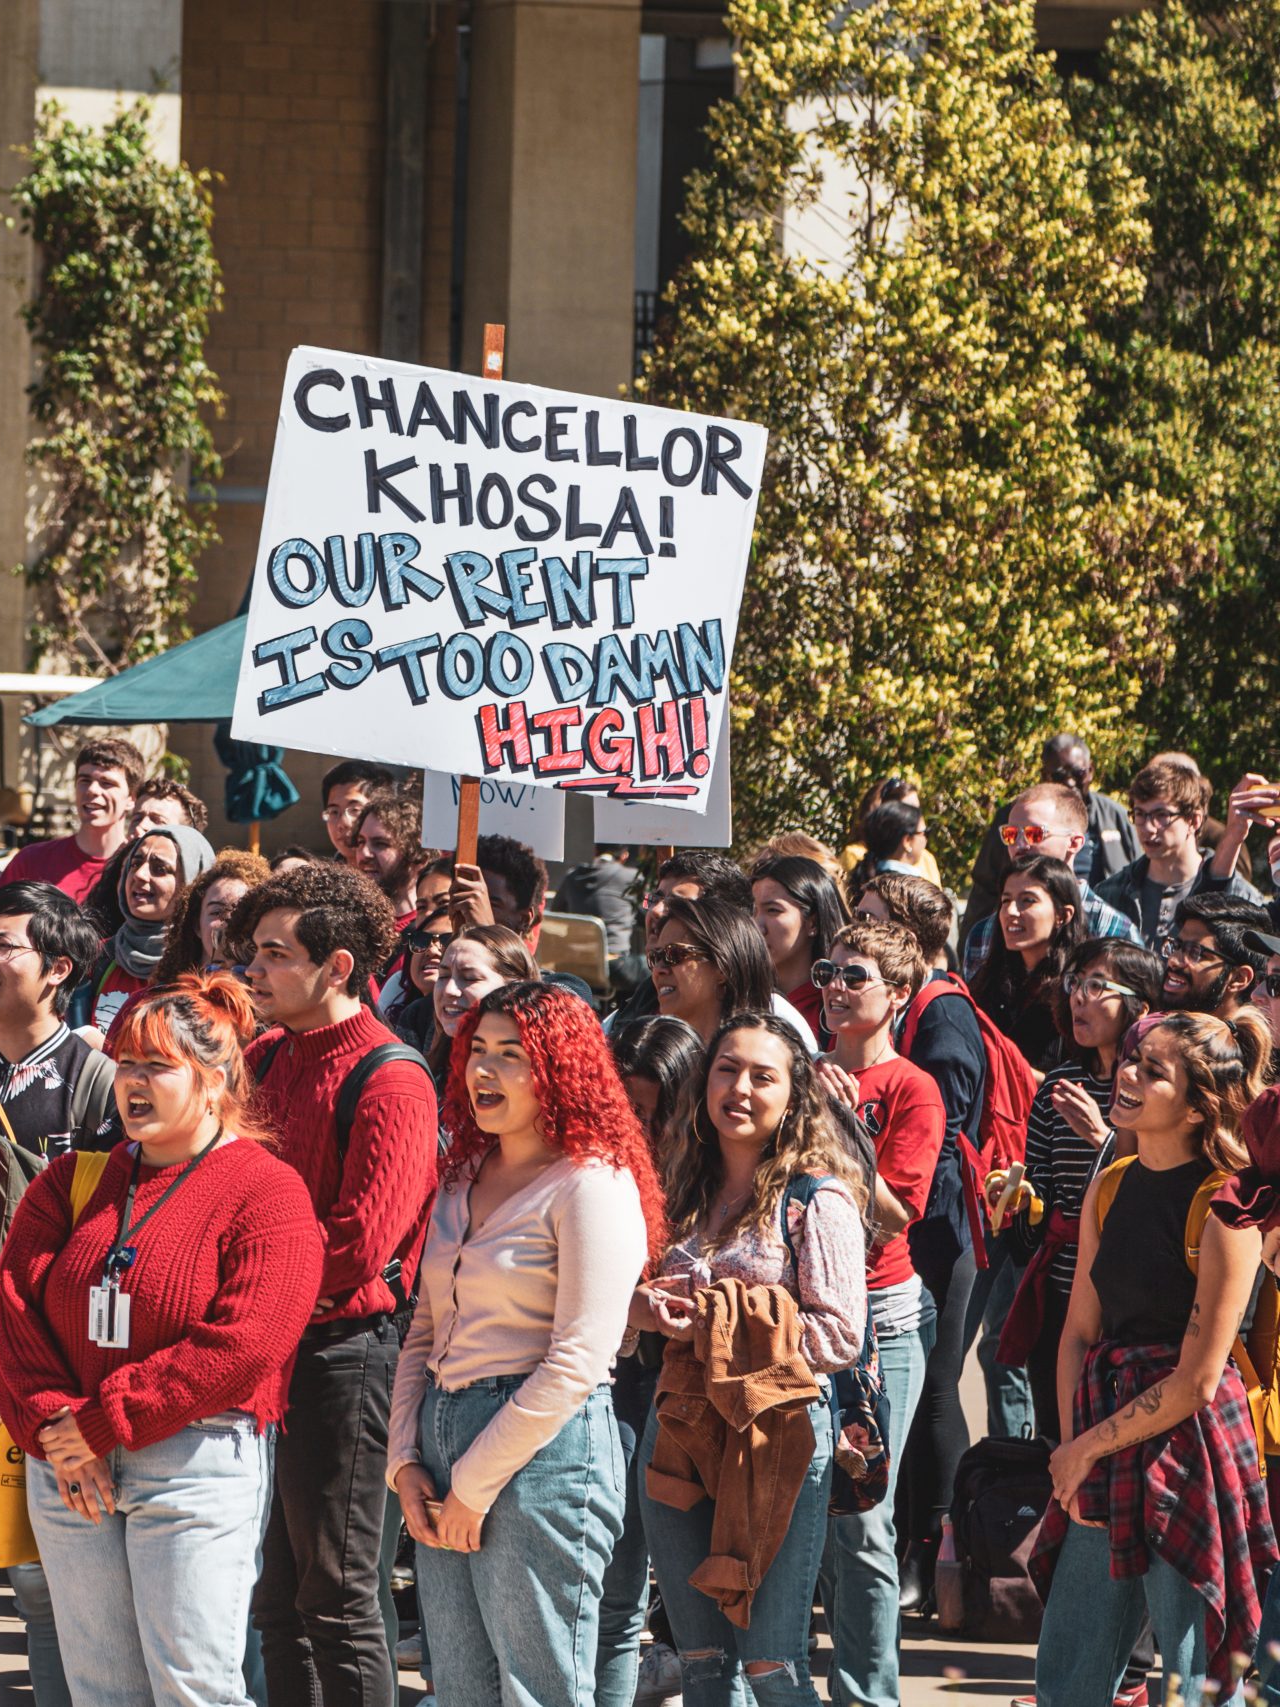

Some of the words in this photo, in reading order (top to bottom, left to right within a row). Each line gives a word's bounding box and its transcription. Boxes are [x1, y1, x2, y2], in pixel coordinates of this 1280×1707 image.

[293, 368, 753, 500] CHANCELLOR
[364, 449, 677, 558] KHOSLA!
[267, 532, 445, 612] OUR
[442, 547, 649, 629] RENT
[253, 619, 374, 715] IS
[374, 632, 534, 706] TOO
[540, 619, 725, 709] DAMN
[474, 698, 711, 779] HIGH!
